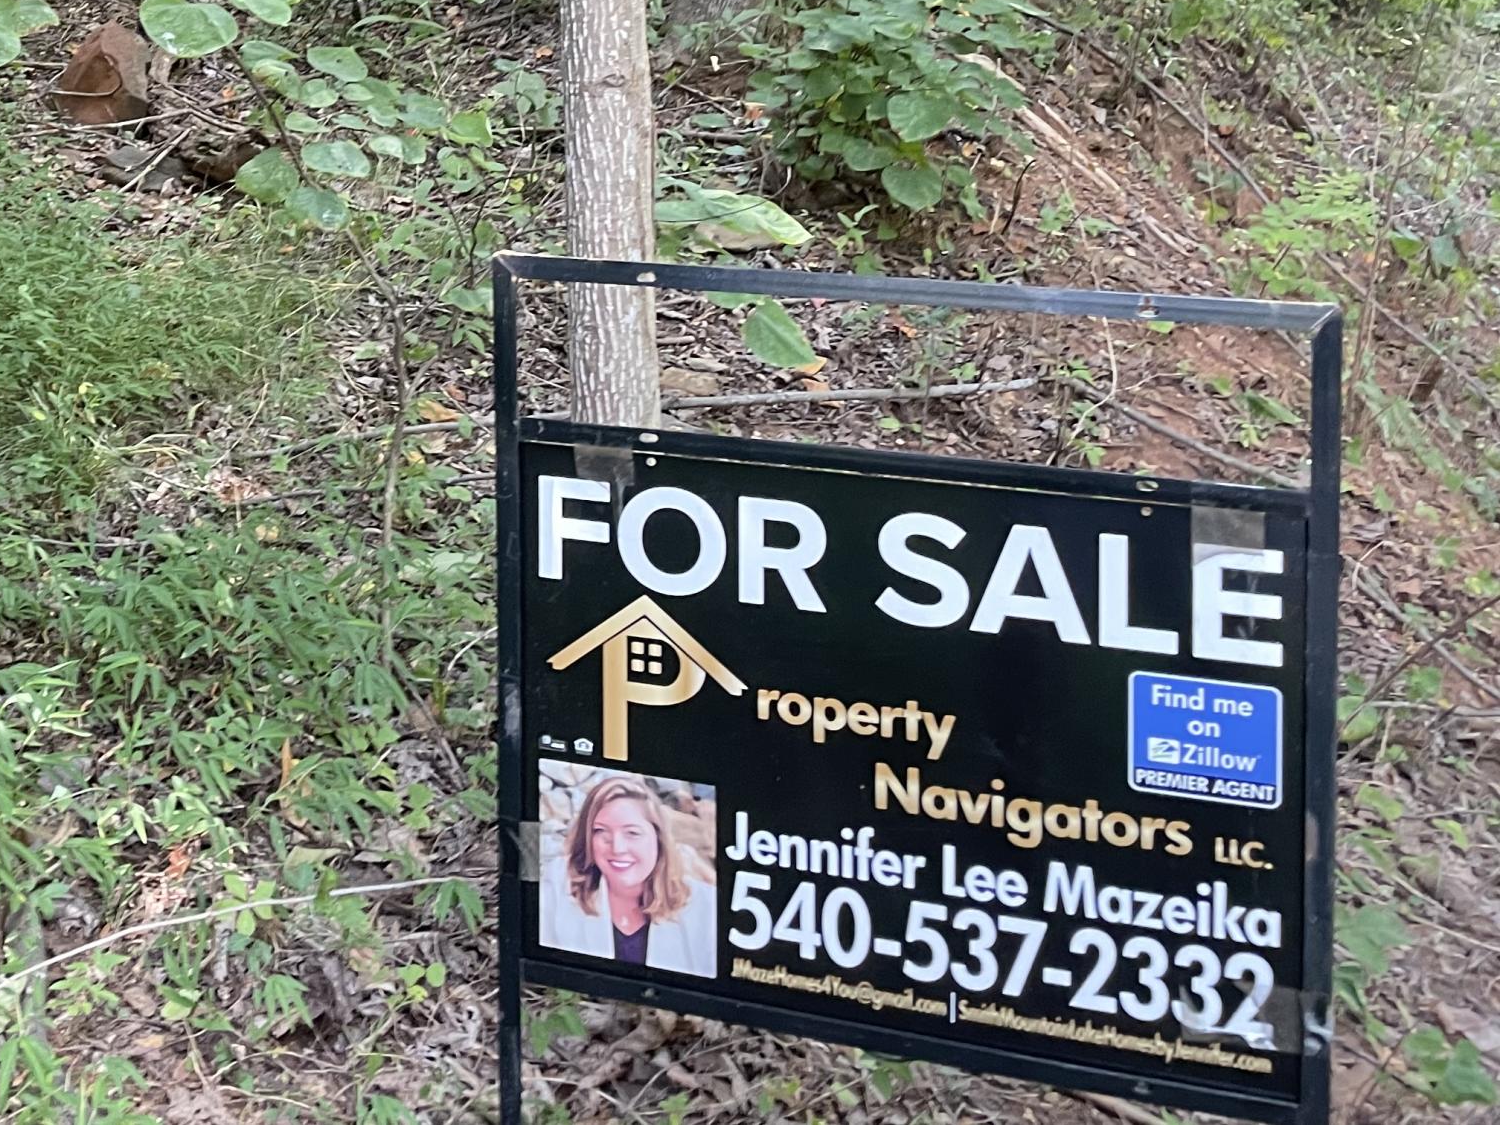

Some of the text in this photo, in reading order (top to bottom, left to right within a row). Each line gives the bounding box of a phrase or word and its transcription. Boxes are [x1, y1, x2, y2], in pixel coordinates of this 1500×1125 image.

[537, 475, 1285, 667] FOR SALE
[1151, 684, 1254, 717] Find me
[1187, 720, 1221, 738] on
[1135, 768, 1276, 802] PREMIER AGENT
[1182, 743, 1257, 772] Zillow
[874, 763, 1274, 870] Navigators LLC.
[725, 811, 1283, 949] Jennifer Lee Mazeika
[728, 871, 1277, 1050] 540-537-2332
